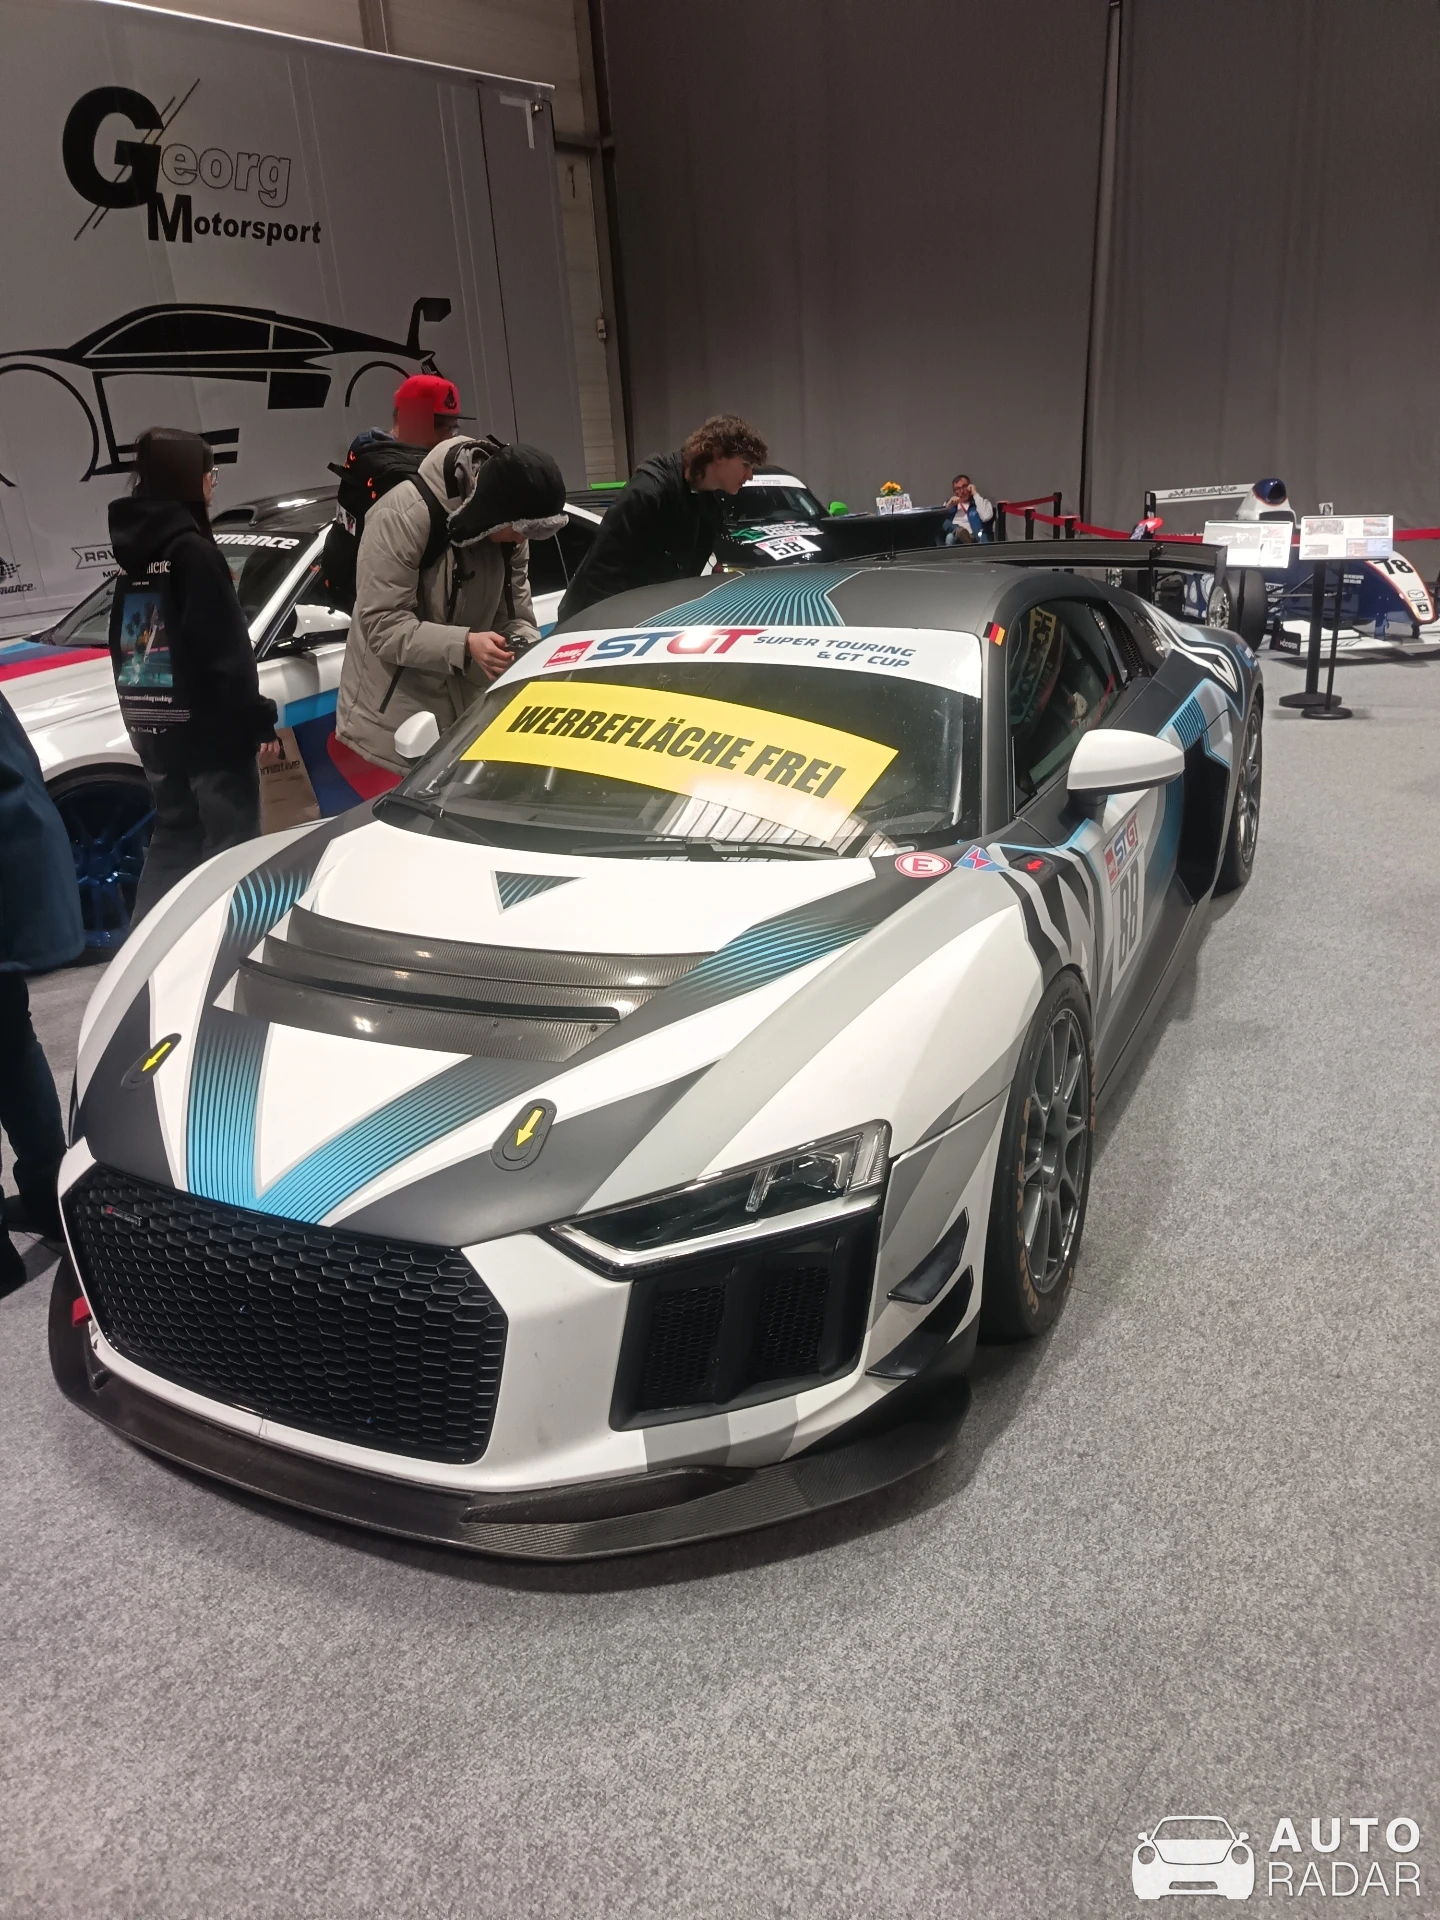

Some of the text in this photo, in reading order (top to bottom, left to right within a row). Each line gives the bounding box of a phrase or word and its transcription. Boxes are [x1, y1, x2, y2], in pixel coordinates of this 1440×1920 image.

[62, 85, 292, 208] Georg
[147, 192, 321, 246] Motorsport
[213, 533, 300, 549] rmance
[769, 541, 806, 556] 58
[1373, 559, 1414, 575] 78
[753, 636, 917, 657] SUPER TOURING
[816, 651, 910, 668] & GT CUP
[506, 705, 847, 799] WERBEFLÄCHE FREI
[912, 858, 933, 872] E
[1118, 856, 1139, 971] 88
